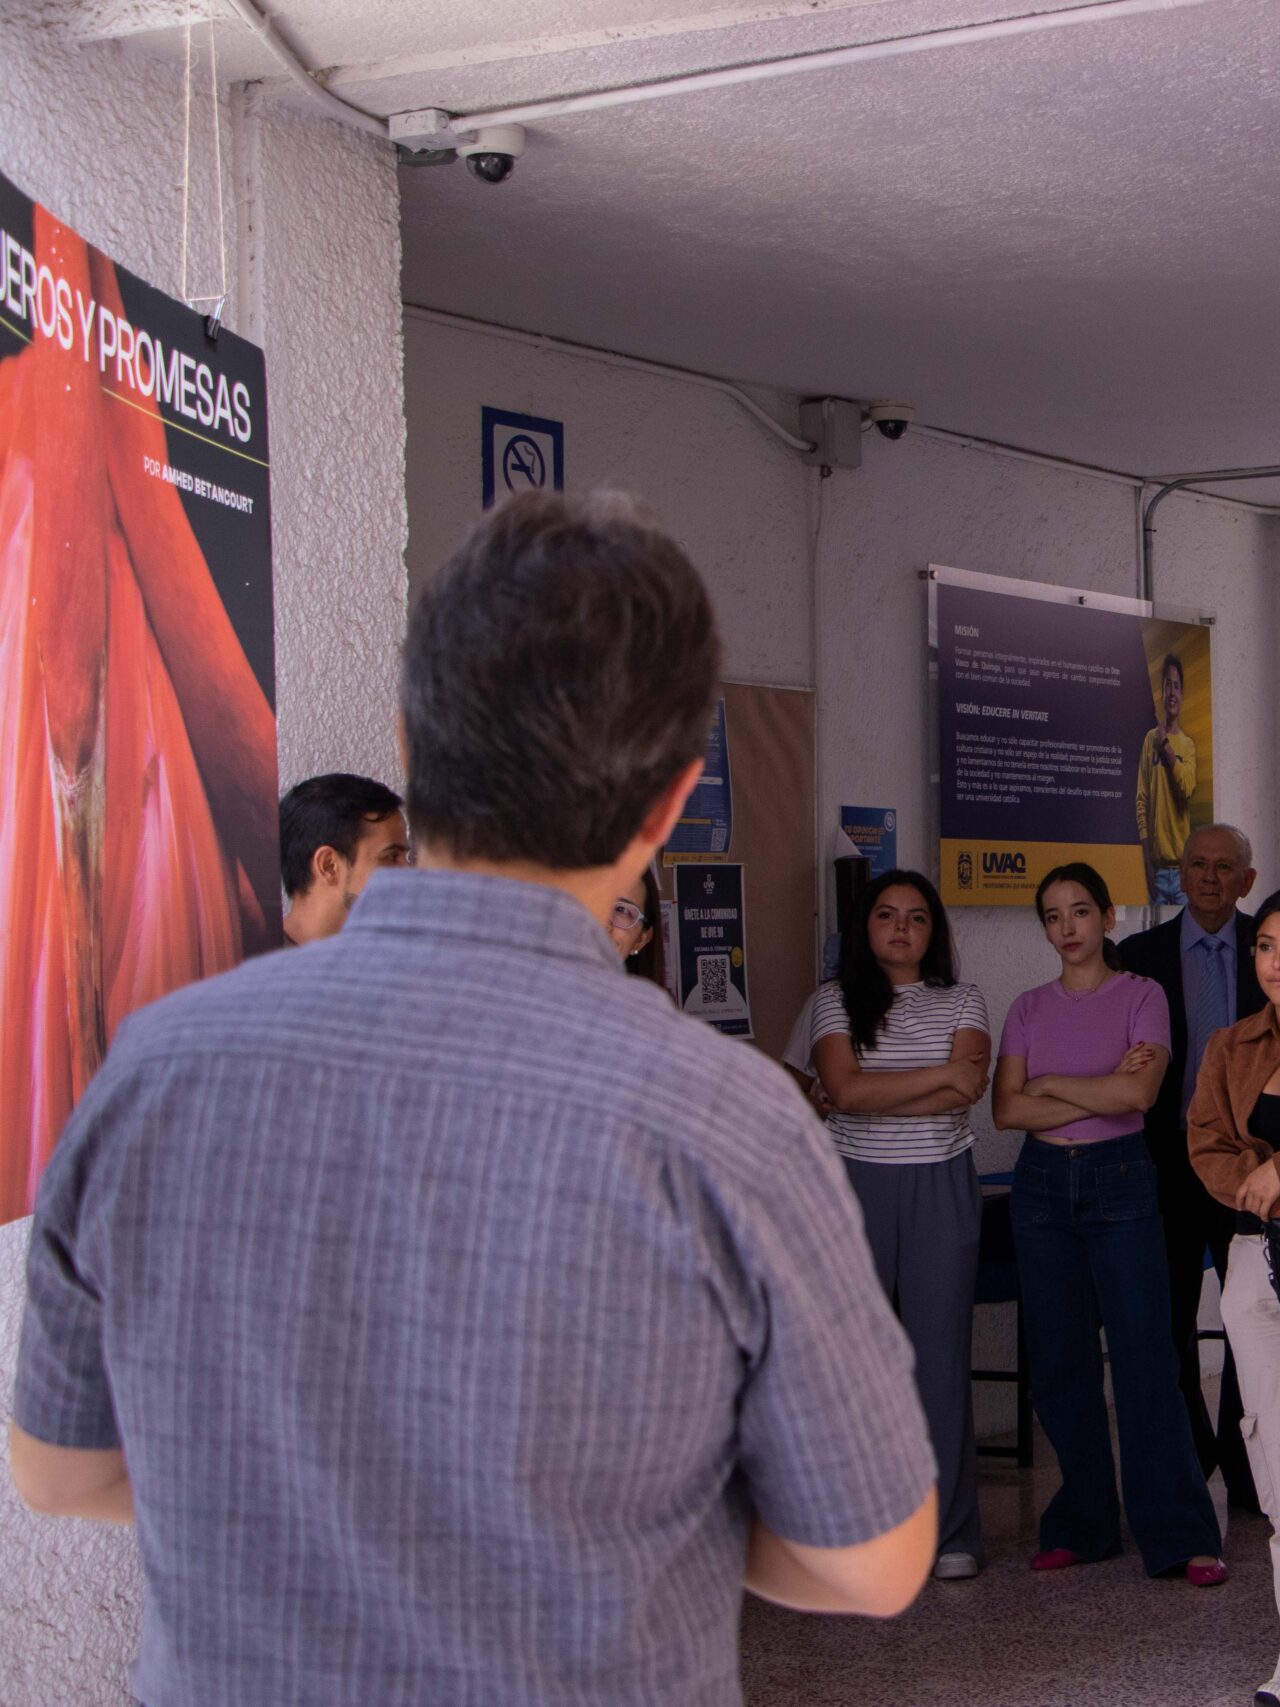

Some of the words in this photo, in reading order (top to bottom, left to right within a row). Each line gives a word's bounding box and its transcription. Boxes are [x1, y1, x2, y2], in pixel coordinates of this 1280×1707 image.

[76, 290, 96, 362] Y
[99, 305, 252, 443] PROMESAS
[144, 456, 161, 476] POR
[161, 466, 194, 492] AMHED
[194, 474, 254, 514] BETANCOURT
[954, 624, 980, 638] MISIÓN
[955, 701, 981, 715] VISIÓN:
[981, 705, 1011, 718] EDUCERE
[1011, 708, 1020, 719] IN
[1020, 709, 1049, 722] VERITATE
[982, 852, 1026, 873] UVAQ
[683, 906, 699, 921] ÚNETE
[699, 908, 704, 920] A
[704, 908, 711, 920] LA
[710, 908, 738, 920] COMUNIDAD
